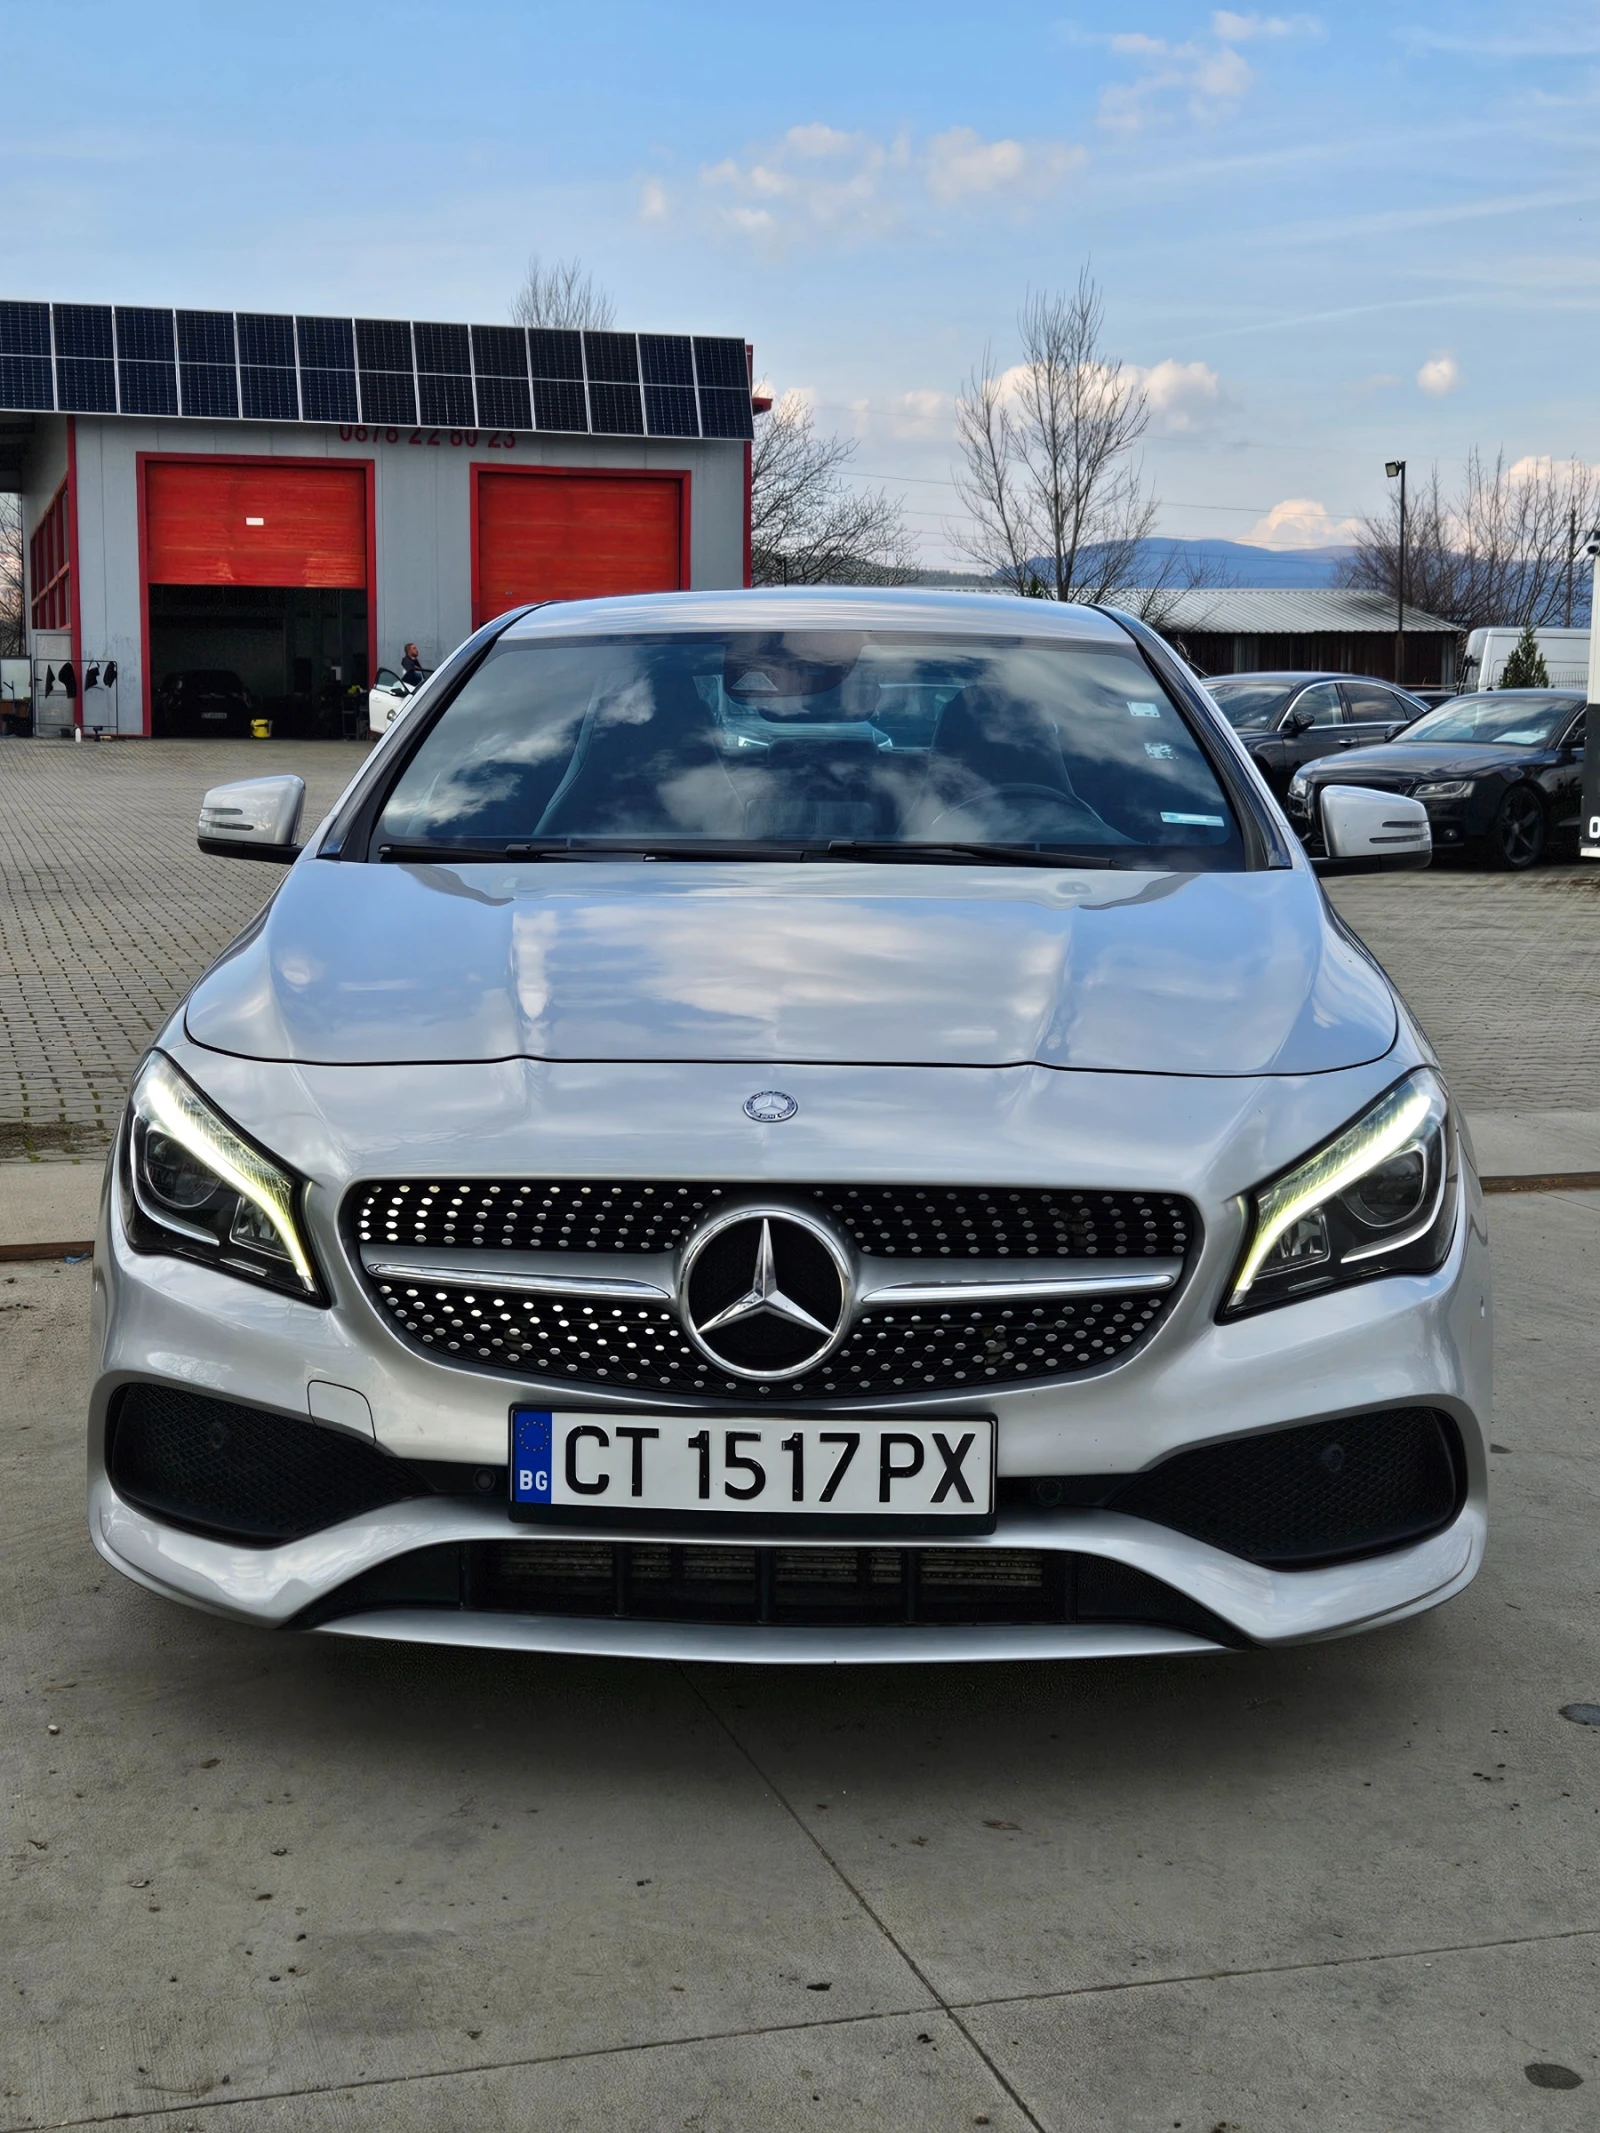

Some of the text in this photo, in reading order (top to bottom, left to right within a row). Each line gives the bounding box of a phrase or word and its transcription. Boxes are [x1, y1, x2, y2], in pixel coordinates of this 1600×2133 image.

[408, 427, 440, 446] 22
[565, 1425, 976, 1503] CT 1517 PX
[519, 1470, 548, 1491] BG
